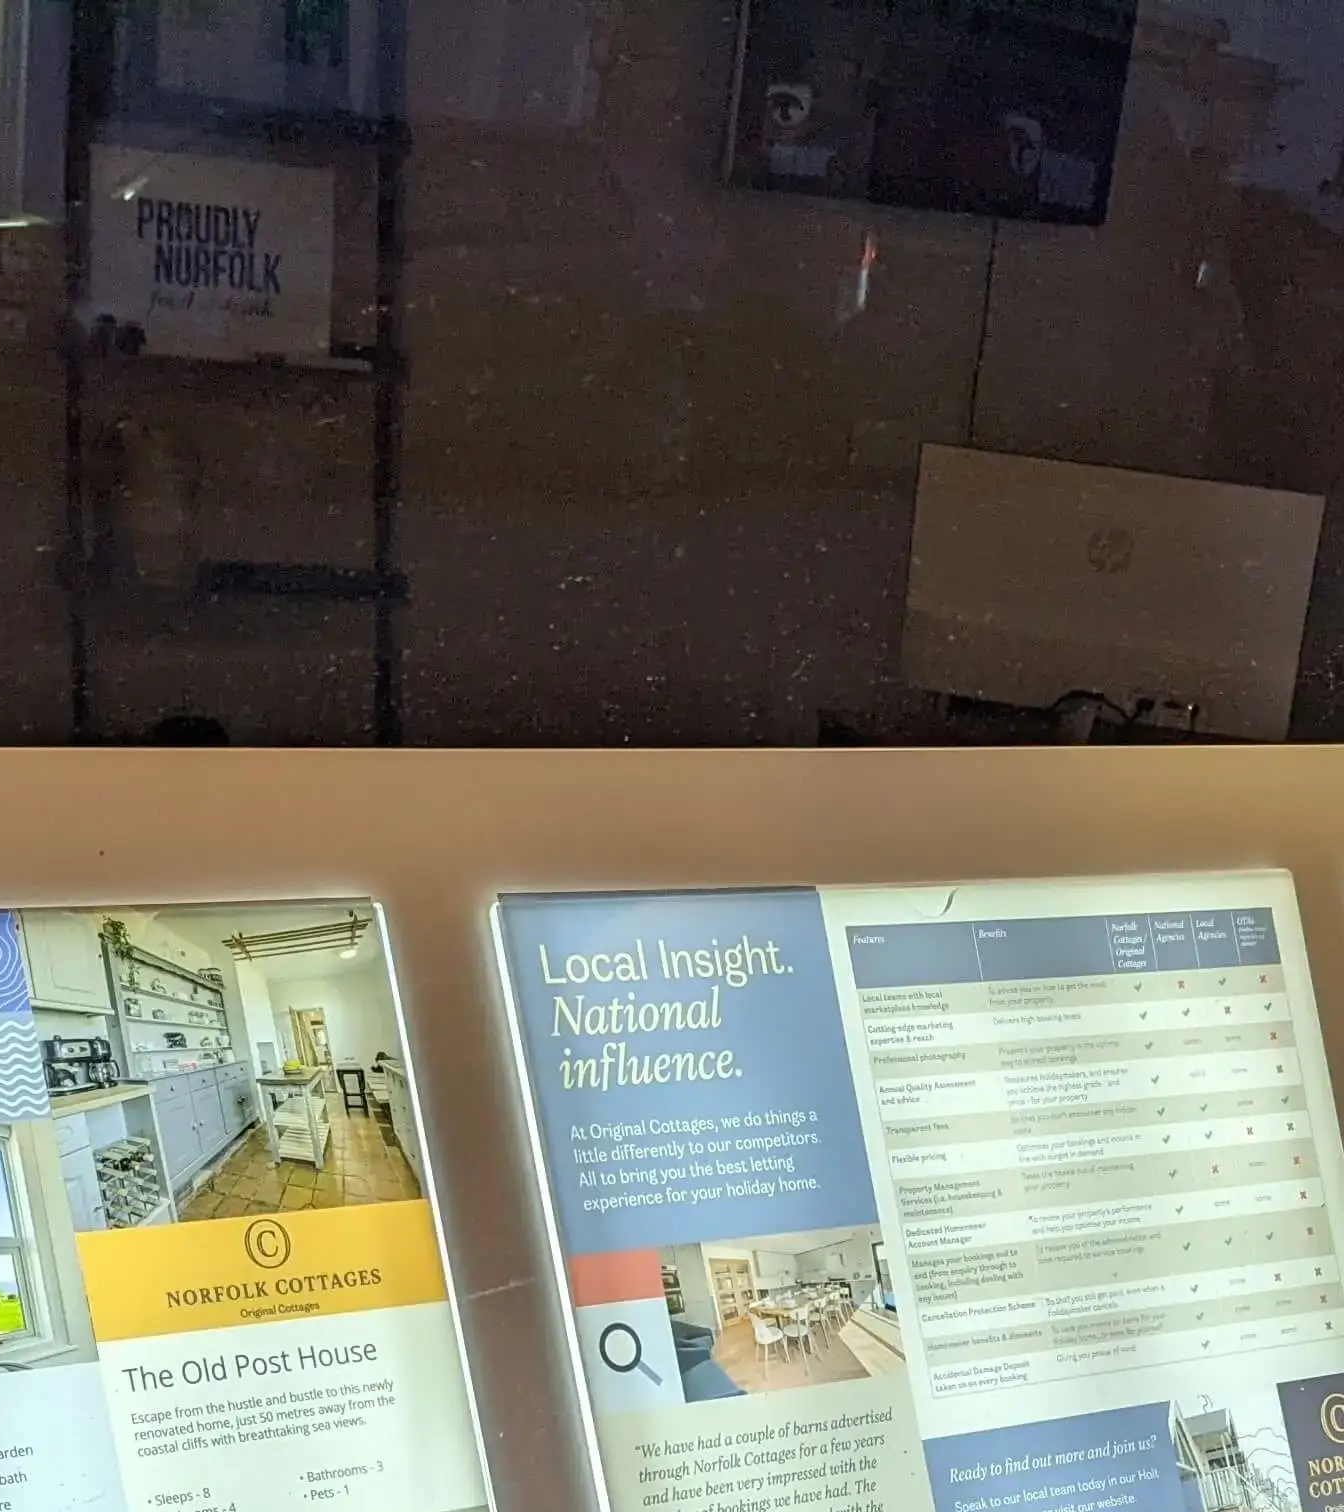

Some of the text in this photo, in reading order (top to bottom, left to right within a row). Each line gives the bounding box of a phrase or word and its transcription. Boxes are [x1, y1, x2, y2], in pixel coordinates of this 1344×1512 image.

[137, 197, 261, 249] PROUDLY
[538, 935, 794, 987] Local Insight.
[550, 985, 721, 1036] National
[558, 1041, 742, 1091] influence.
[570, 1109, 818, 1142] At Original Cottages, we do things a
[572, 1130, 822, 1164] little differently to our competitors.
[582, 1177, 820, 1214] experience for your holiday home.
[165, 1267, 381, 1308] NORFOLK COTTAGES
[239, 1301, 320, 1319] Original Cottages
[122, 1342, 377, 1392] The Old Post House
[130, 1378, 393, 1424] Escape from the hustle and bustle to this newly
[638, 1434, 885, 1483] through Norfolk Cottages for a few years
[949, 1433, 1157, 1483] Ready to find out more and join us?
